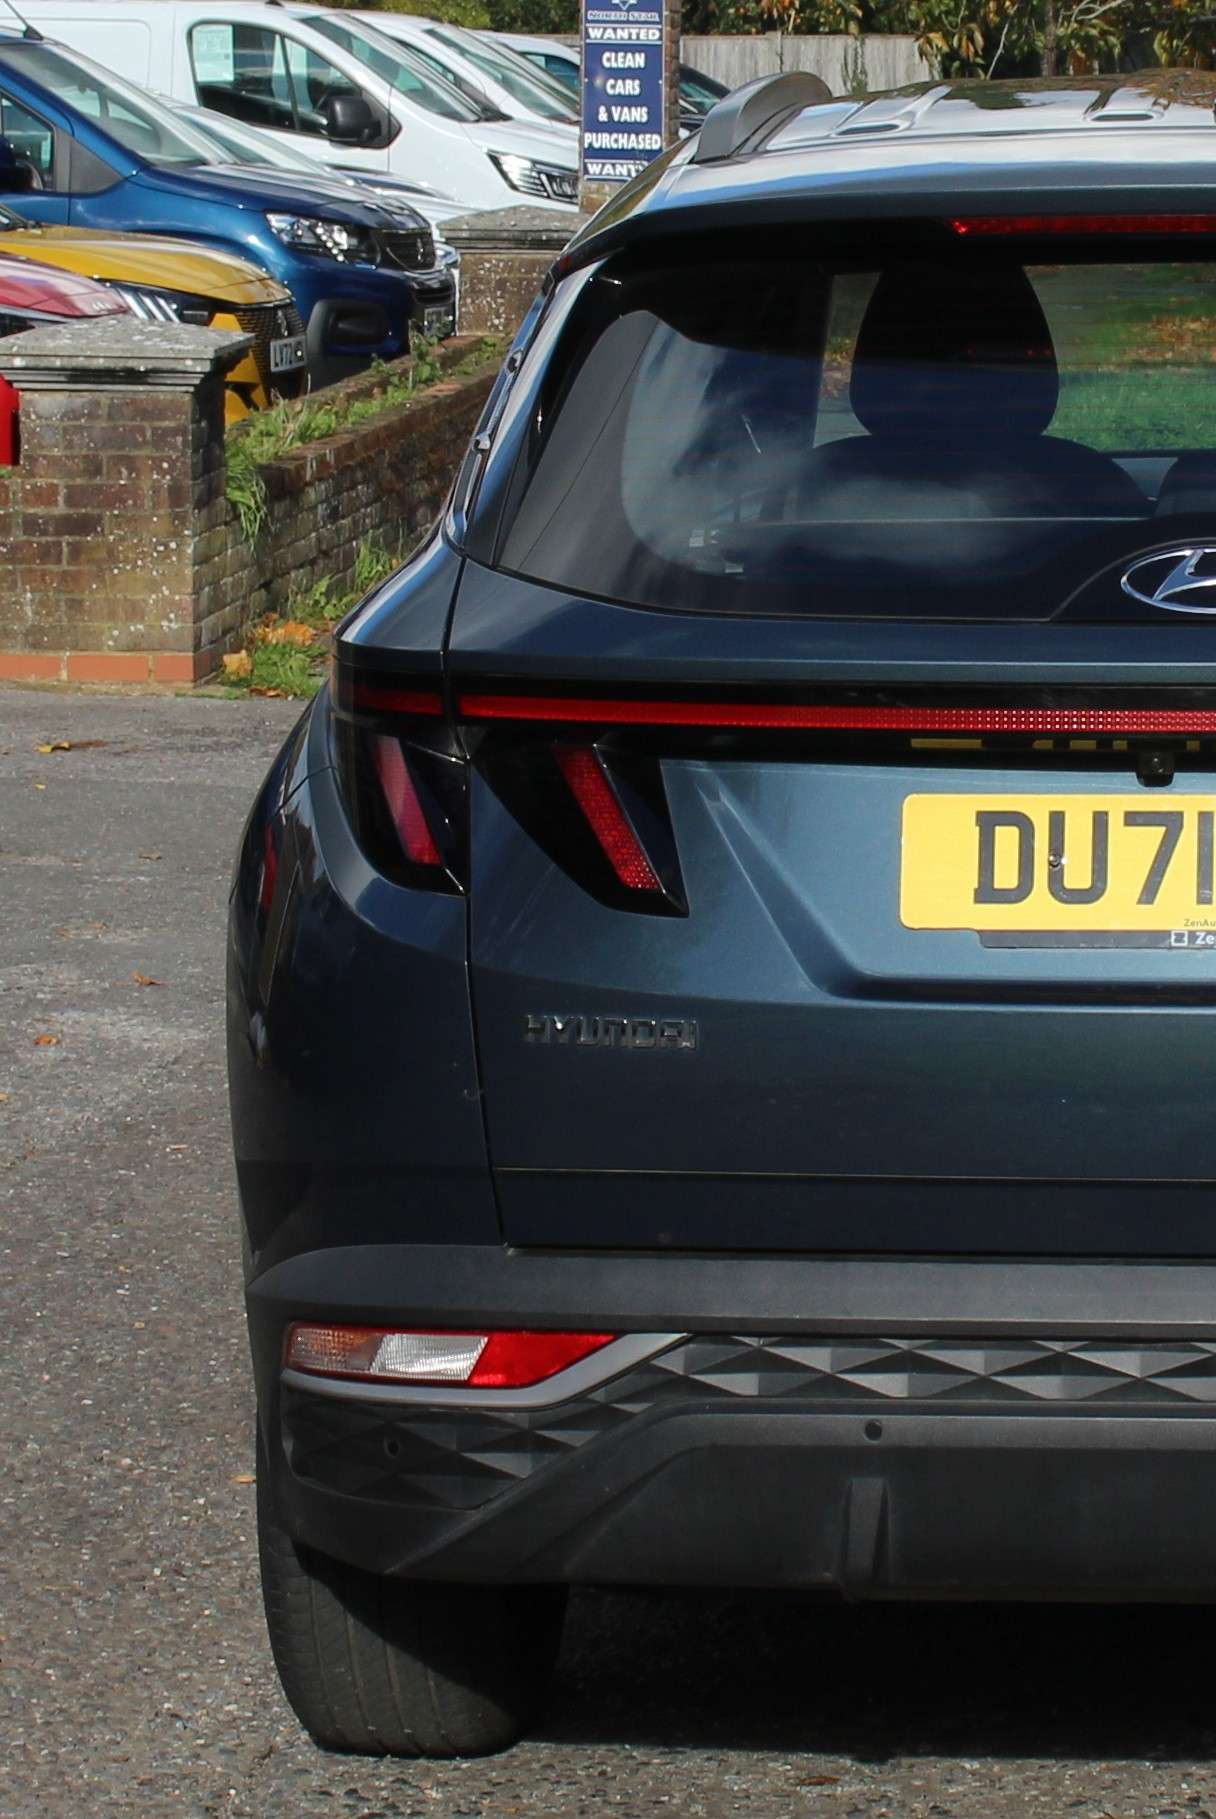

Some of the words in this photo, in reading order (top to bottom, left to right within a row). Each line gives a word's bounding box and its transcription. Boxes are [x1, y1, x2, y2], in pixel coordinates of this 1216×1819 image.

[588, 27, 660, 40] WANTED
[602, 51, 645, 69] CLEAN
[606, 78, 641, 96] CARS
[598, 105, 608, 122] &
[611, 105, 648, 123] VANS
[584, 132, 661, 150] PURCHASED
[587, 163, 644, 177] WANT
[973, 810, 1214, 905] DU71
